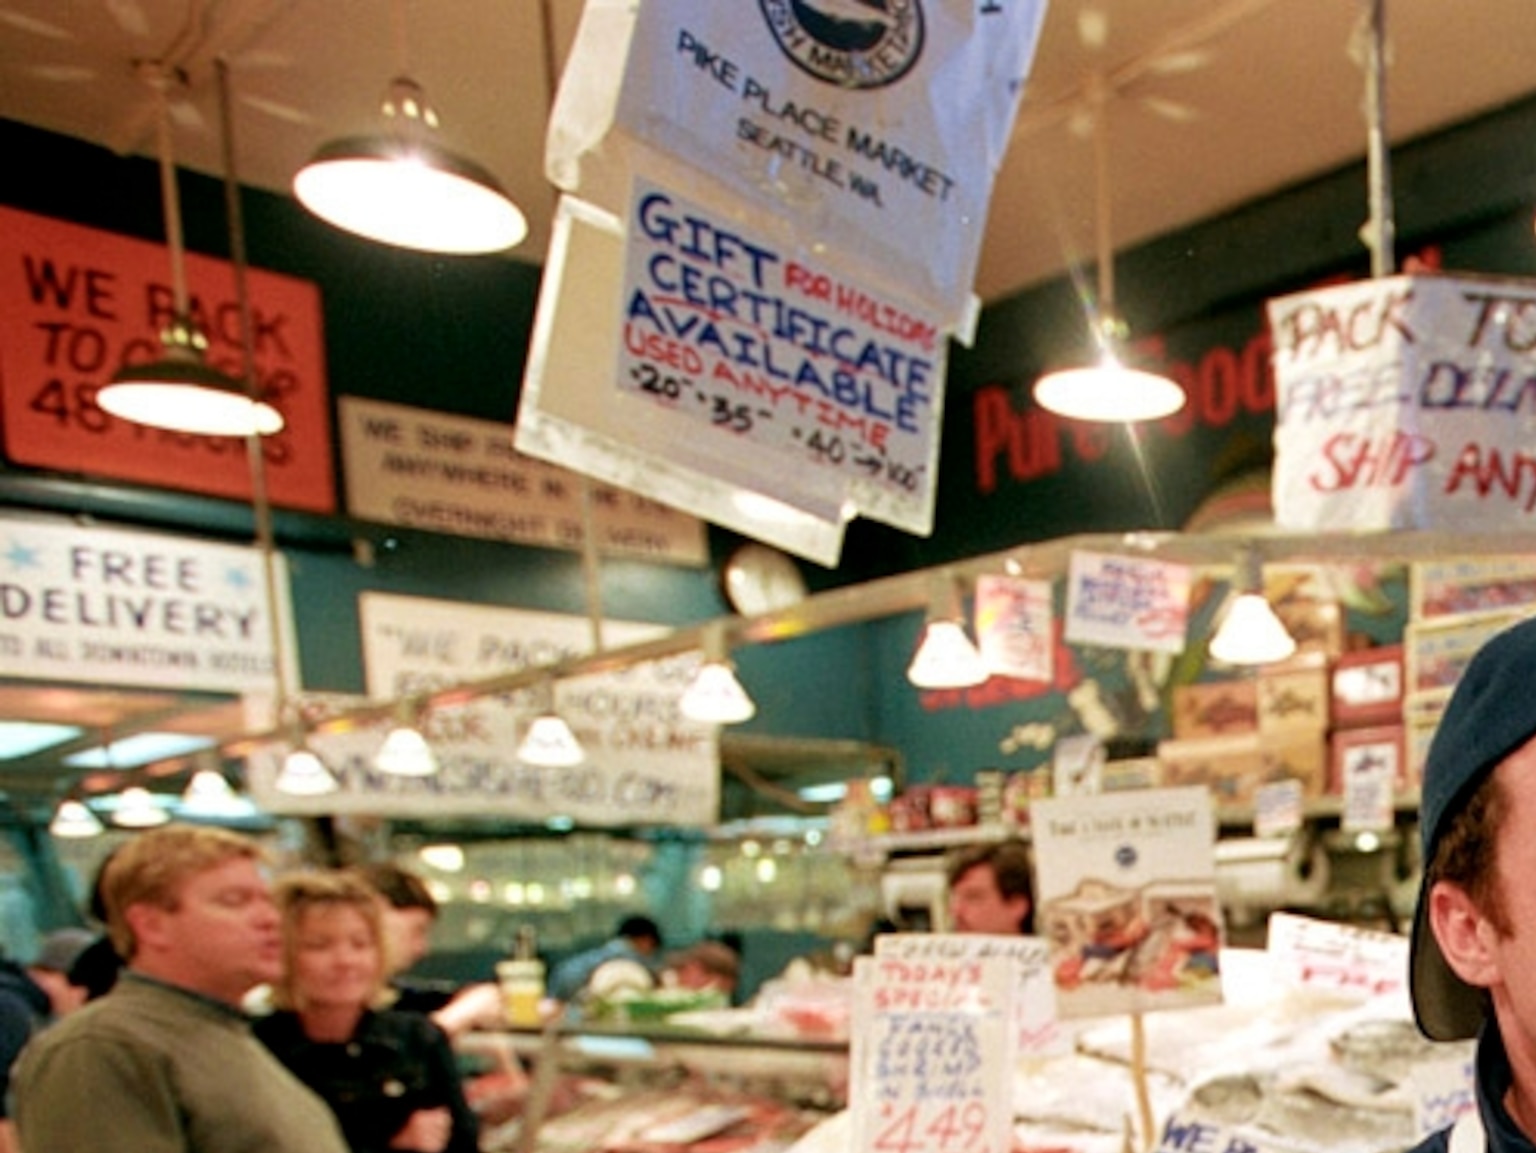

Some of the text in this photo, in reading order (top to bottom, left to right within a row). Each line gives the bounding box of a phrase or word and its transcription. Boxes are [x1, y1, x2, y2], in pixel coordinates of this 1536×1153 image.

[676, 29, 956, 203] PIKE PLACE MARKET
[638, 192, 779, 289] GIFT
[23, 253, 118, 323] WE
[33, 321, 107, 373] TO
[627, 288, 919, 433] AVAILABLE
[649, 253, 932, 404] CERTIFICATE
[1280, 289, 1416, 363] PACK
[623, 321, 892, 448] USED ANYTIME
[1308, 427, 1437, 493] SHIP
[69, 545, 201, 592] FREE
[0, 582, 259, 639] DELIVERY
